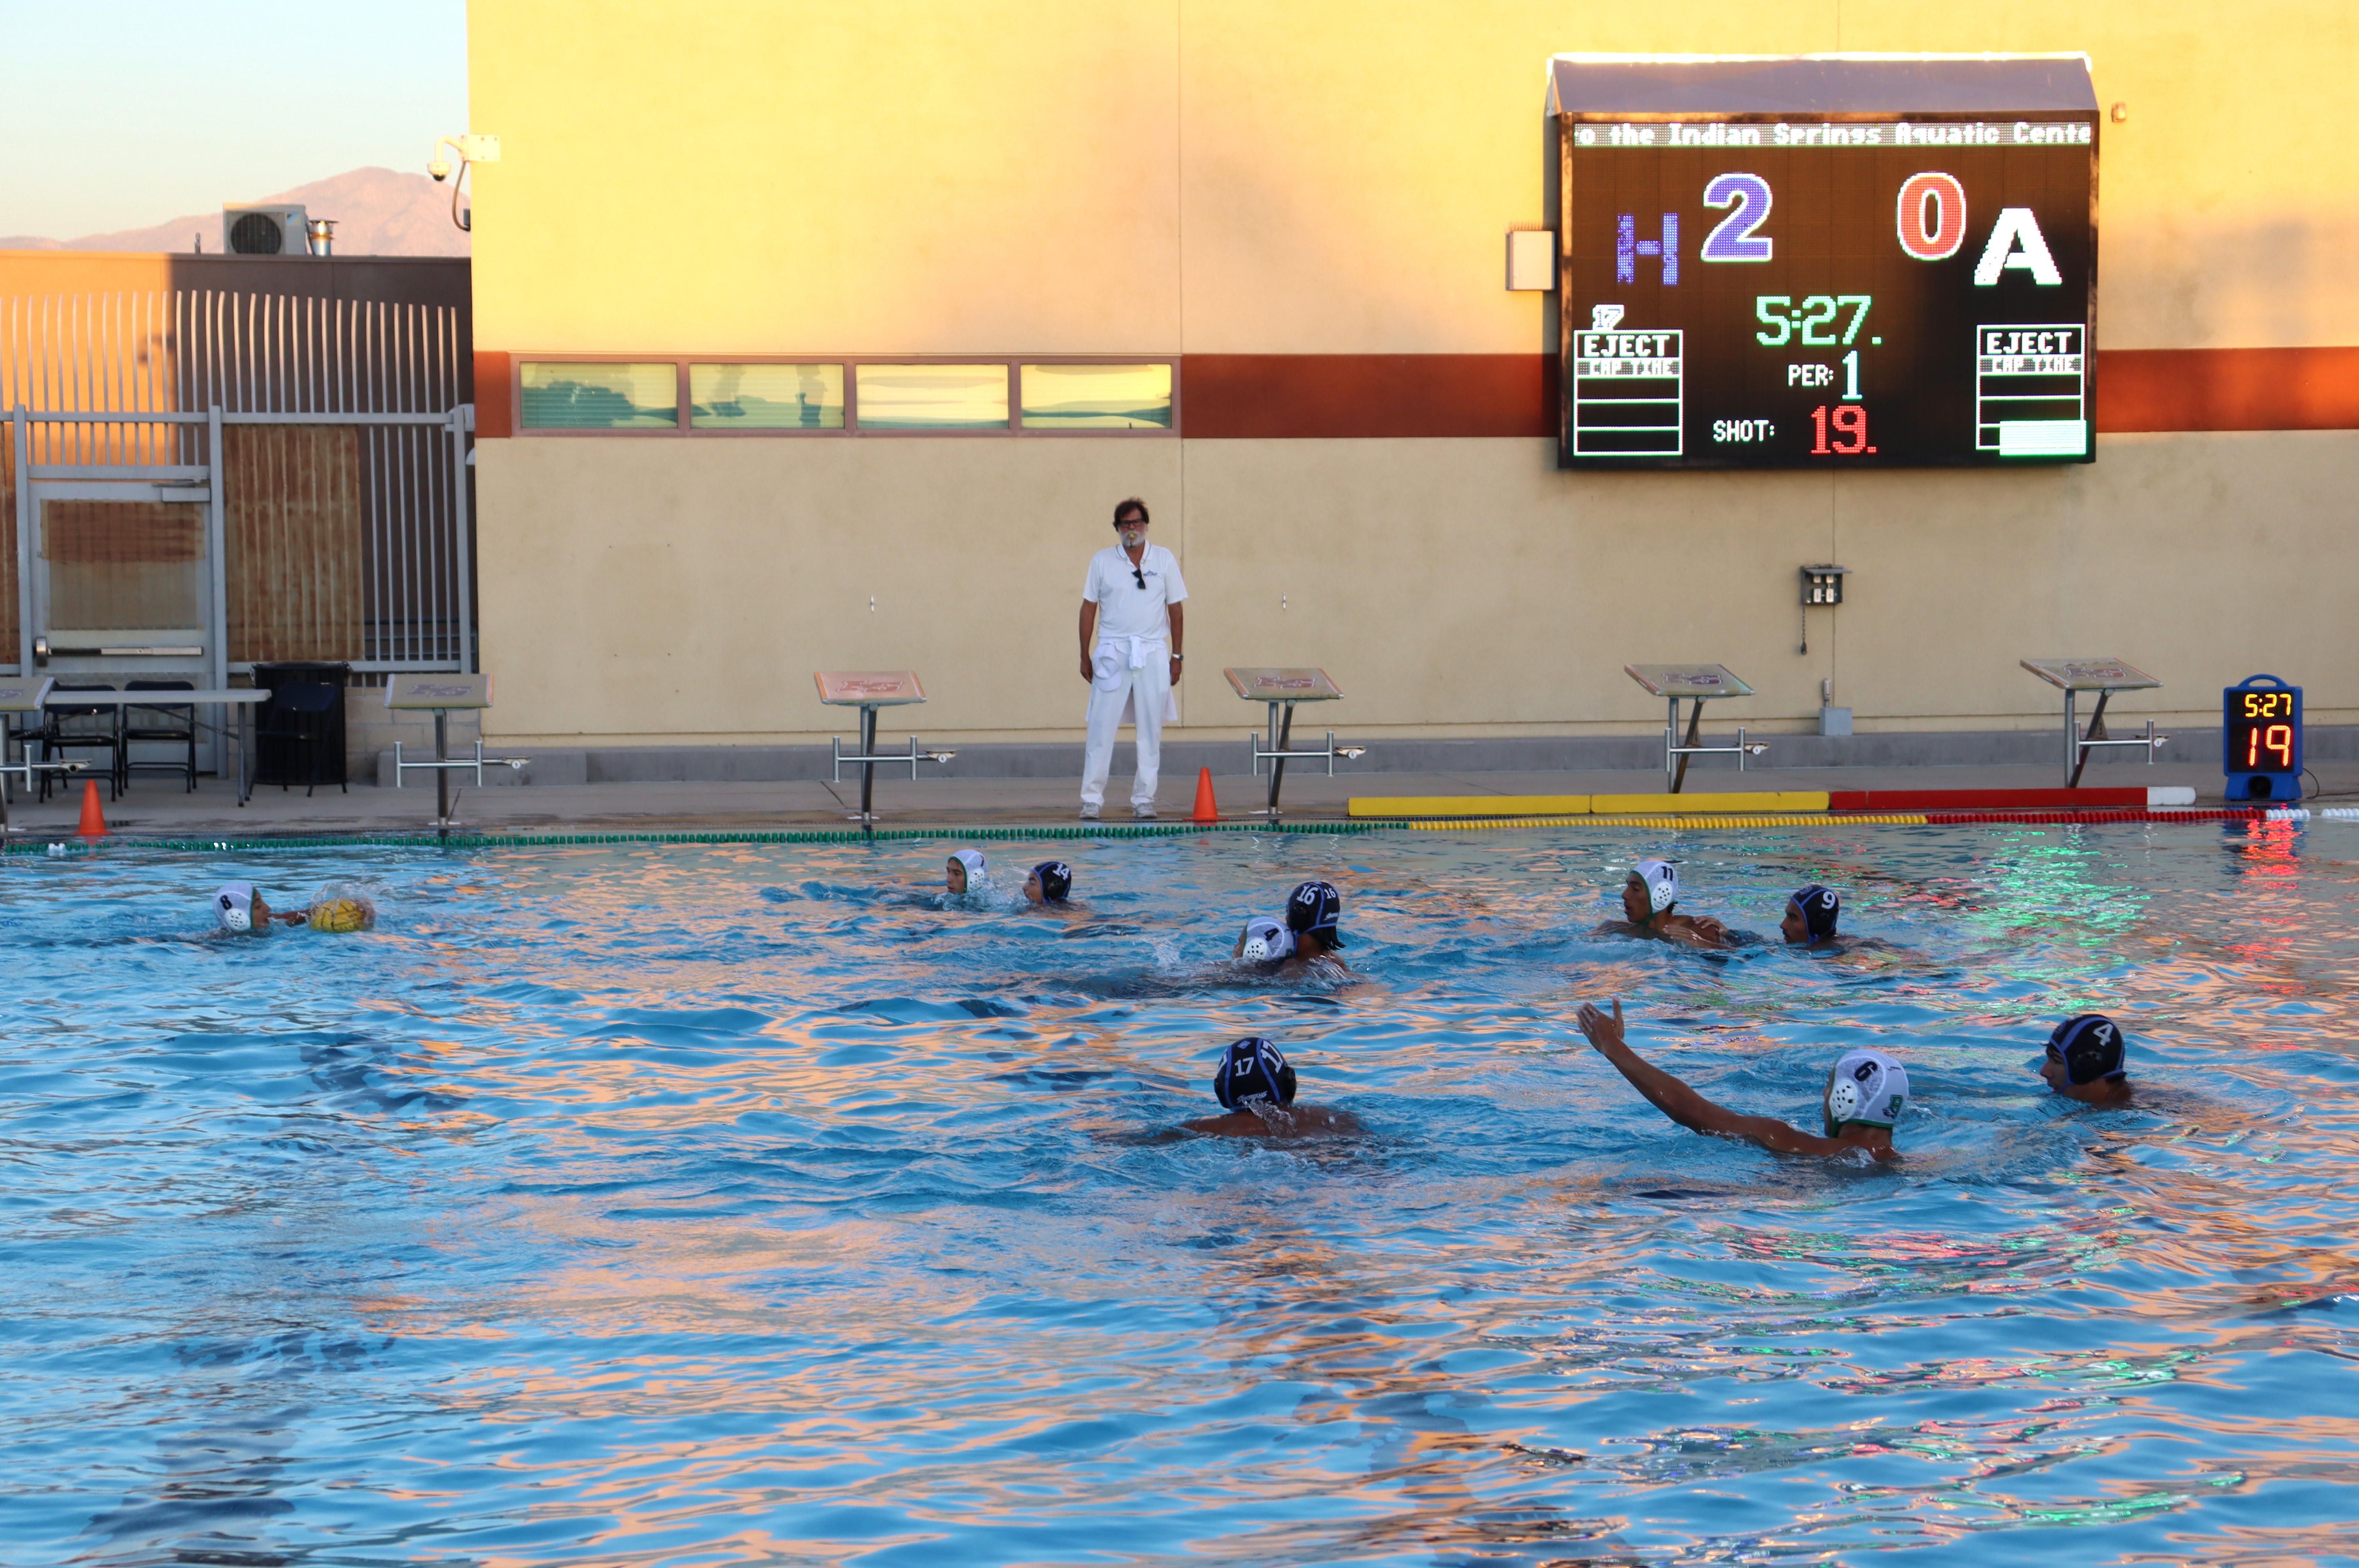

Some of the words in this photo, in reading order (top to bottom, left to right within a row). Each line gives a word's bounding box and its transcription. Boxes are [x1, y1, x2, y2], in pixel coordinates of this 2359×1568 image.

[1574, 127, 1595, 145] o
[1610, 123, 1655, 145] the
[1669, 123, 1760, 145] Indian
[1774, 123, 1881, 145] Springs
[1895, 122, 2000, 145] Aquatic
[1700, 172, 1773, 262] 2
[1896, 172, 1967, 260] 0
[1617, 213, 1679, 284] H
[1974, 207, 2062, 285] A
[1584, 335, 1670, 357] EJECT
[1987, 332, 2073, 354] EJECT
[1788, 364, 1835, 387] PER:
[1841, 350, 1863, 400] 1
[1713, 419, 1776, 443] SHOT:
[2245, 693, 2292, 717] 5:27
[2249, 725, 2291, 766] 19
[1053, 863, 1070, 881] 14
[1661, 866, 1673, 882] 11
[220, 894, 233, 910] 8
[1296, 885, 1319, 905] 16
[1324, 887, 1336, 899] 16
[1821, 891, 1836, 910] 9
[1264, 927, 1280, 942] 4
[2092, 1023, 2114, 1047] 4
[1234, 1056, 1254, 1077] 17
[1854, 1061, 1878, 1082] 6
